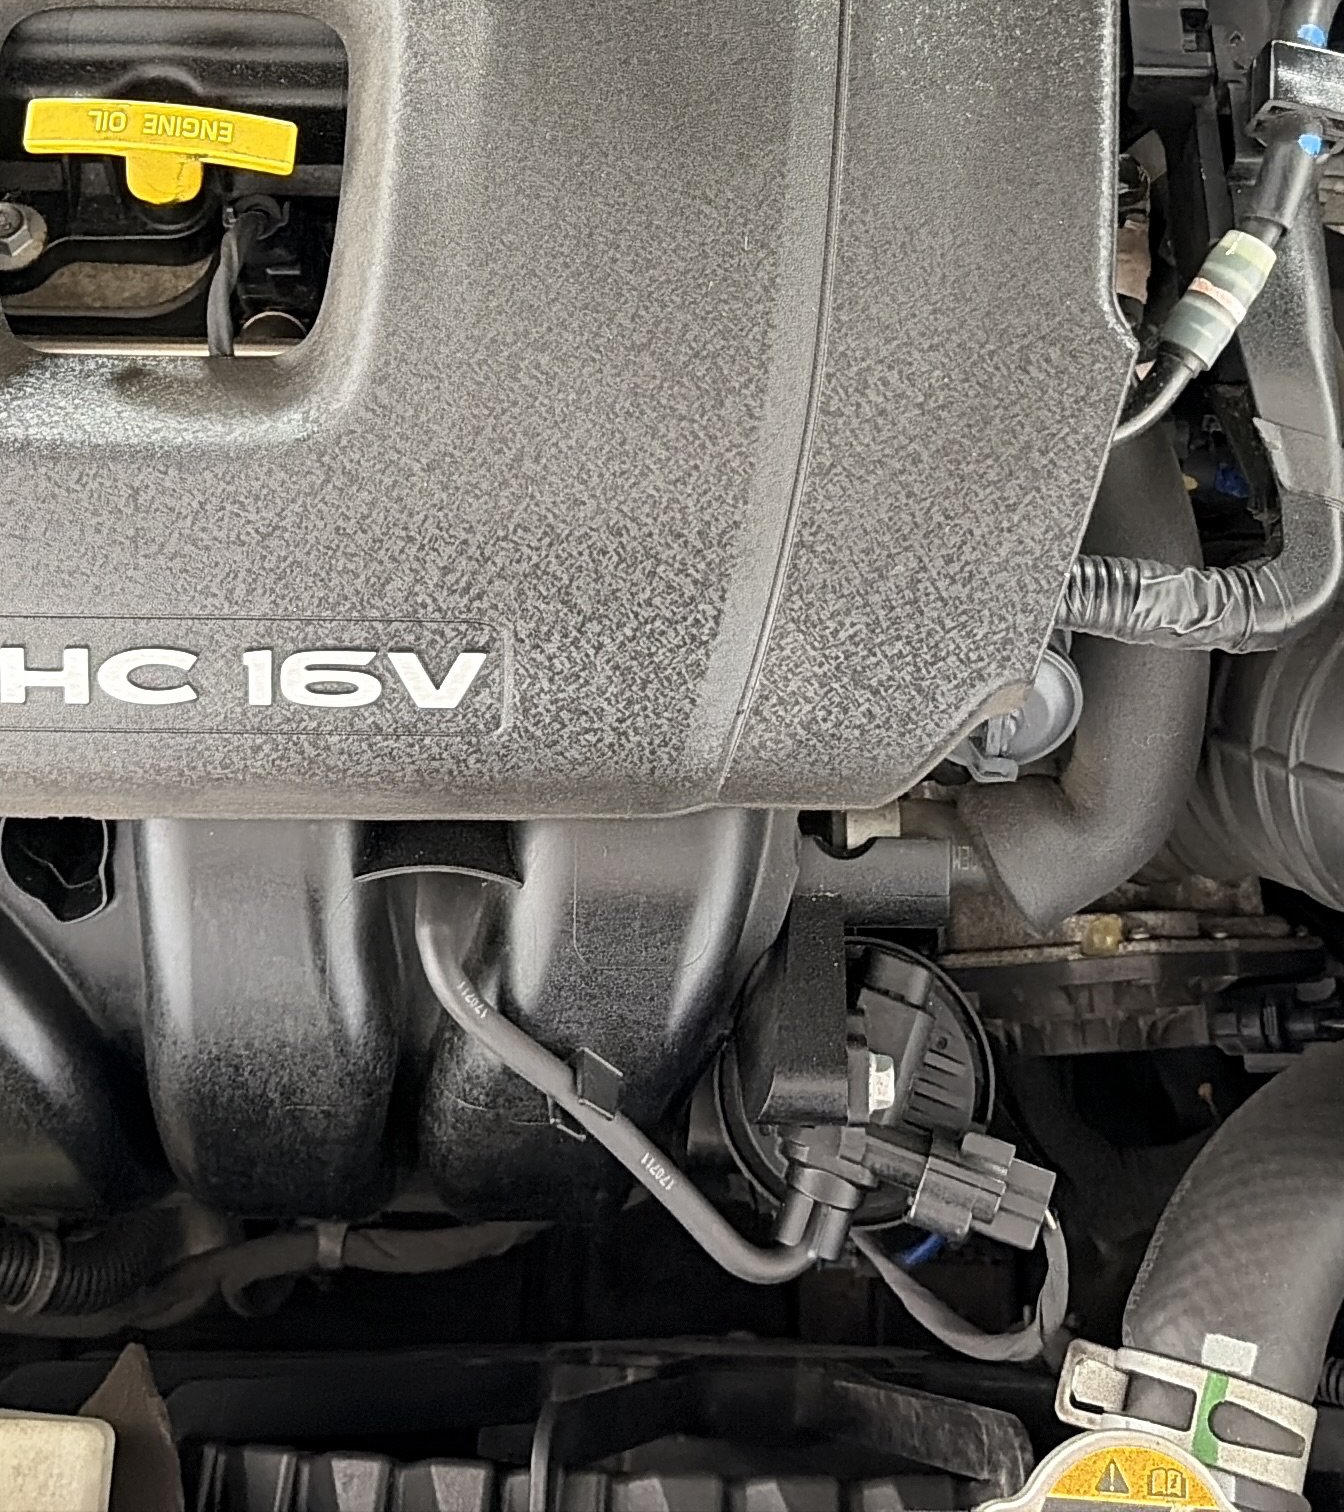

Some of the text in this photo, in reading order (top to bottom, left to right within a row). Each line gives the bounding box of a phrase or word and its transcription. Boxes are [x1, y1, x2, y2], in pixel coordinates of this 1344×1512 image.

[88, 110, 233, 143] ENGINE OIL
[243, 646, 488, 709] 16V
[639, 1151, 676, 1192] 170711
